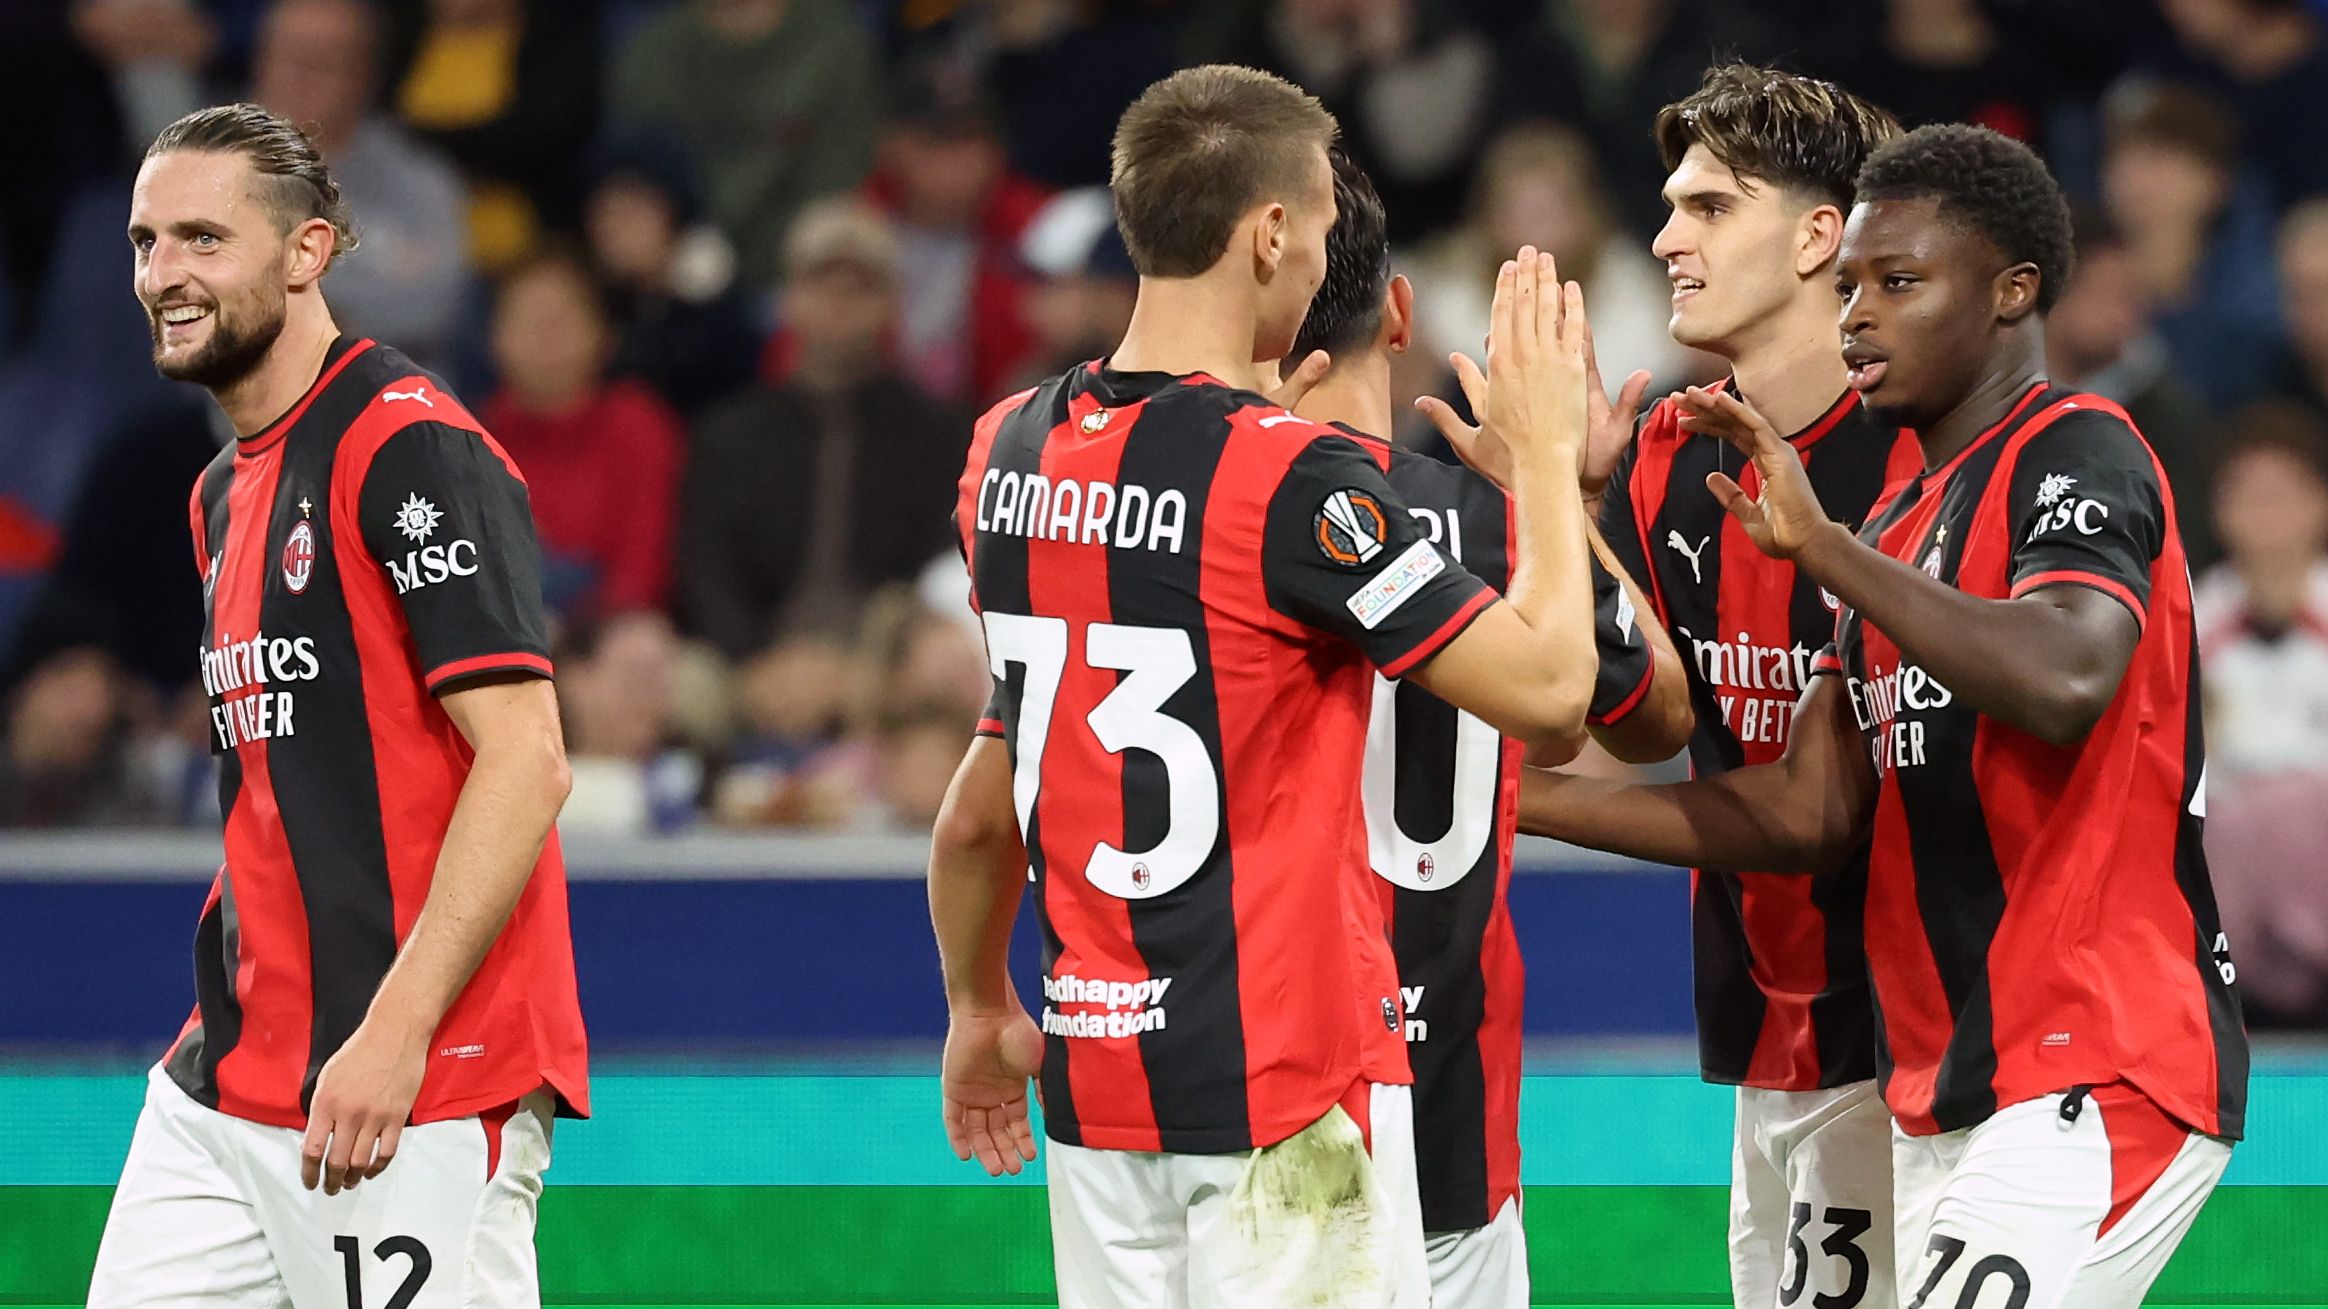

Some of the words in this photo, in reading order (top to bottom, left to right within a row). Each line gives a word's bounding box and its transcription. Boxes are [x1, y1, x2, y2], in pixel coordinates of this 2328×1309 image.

[976, 468, 1187, 554] CAMARDA
[385, 539, 478, 595] MSC
[1677, 625, 1823, 691] mirat
[1847, 660, 1952, 732] Emirtes
[980, 610, 1220, 899] 73
[1042, 974, 1172, 1010] adhappy
[333, 1234, 433, 1309] 12
[1780, 1201, 1872, 1309] 33
